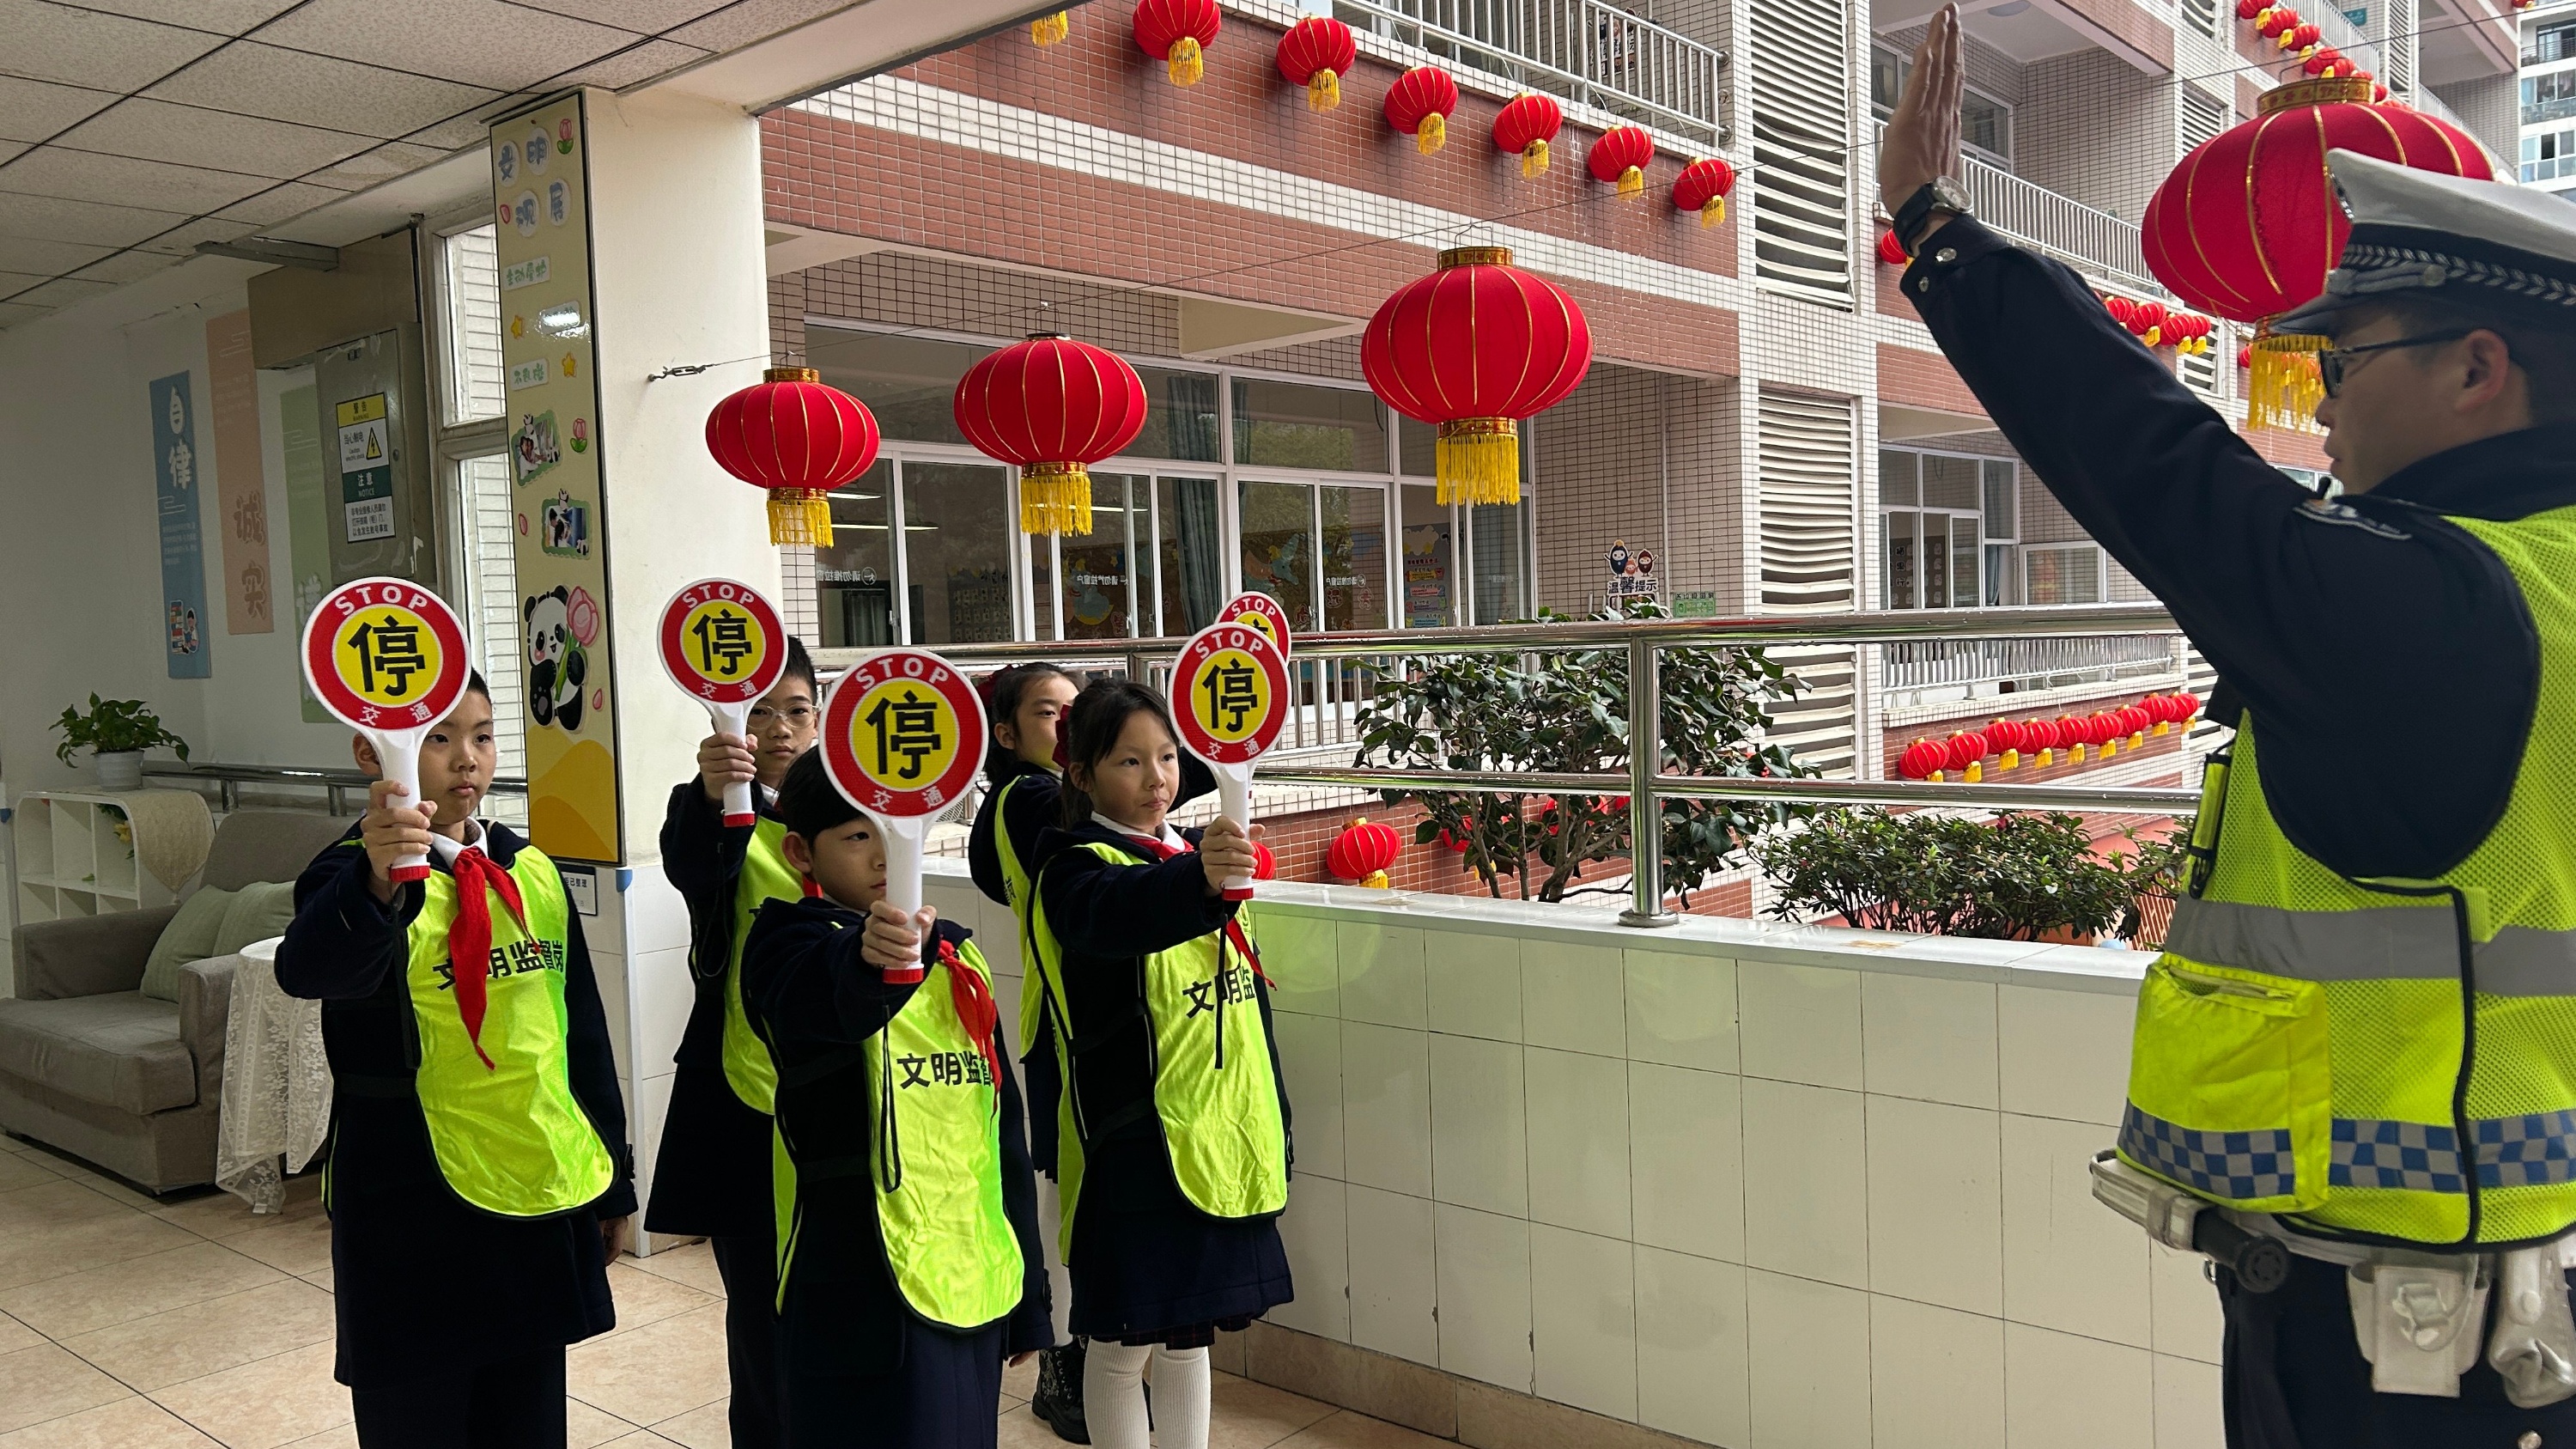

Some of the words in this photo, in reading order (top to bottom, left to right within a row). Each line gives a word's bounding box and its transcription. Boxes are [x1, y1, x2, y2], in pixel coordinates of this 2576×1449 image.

[353, 400, 368, 414] 警告
[168, 385, 193, 490] 自律
[343, 430, 364, 445] 当心触电
[357, 472, 374, 487] 注意
[358, 487, 375, 498] NOTICE
[234, 491, 267, 620] 诚实
[683, 584, 755, 609] STOP
[1608, 576, 1658, 594] 温馨提示
[335, 585, 428, 616] STOP
[1231, 595, 1276, 617] STOP
[691, 608, 752, 675] 停
[1194, 630, 1263, 660] STOP
[348, 614, 426, 697] 停
[855, 657, 949, 691] STOP
[700, 679, 758, 699] 交通
[1202, 657, 1258, 733] 停
[359, 701, 433, 727] 交通
[865, 690, 941, 779] 停
[1207, 738, 1261, 760] 交通
[870, 785, 945, 812] 交通
